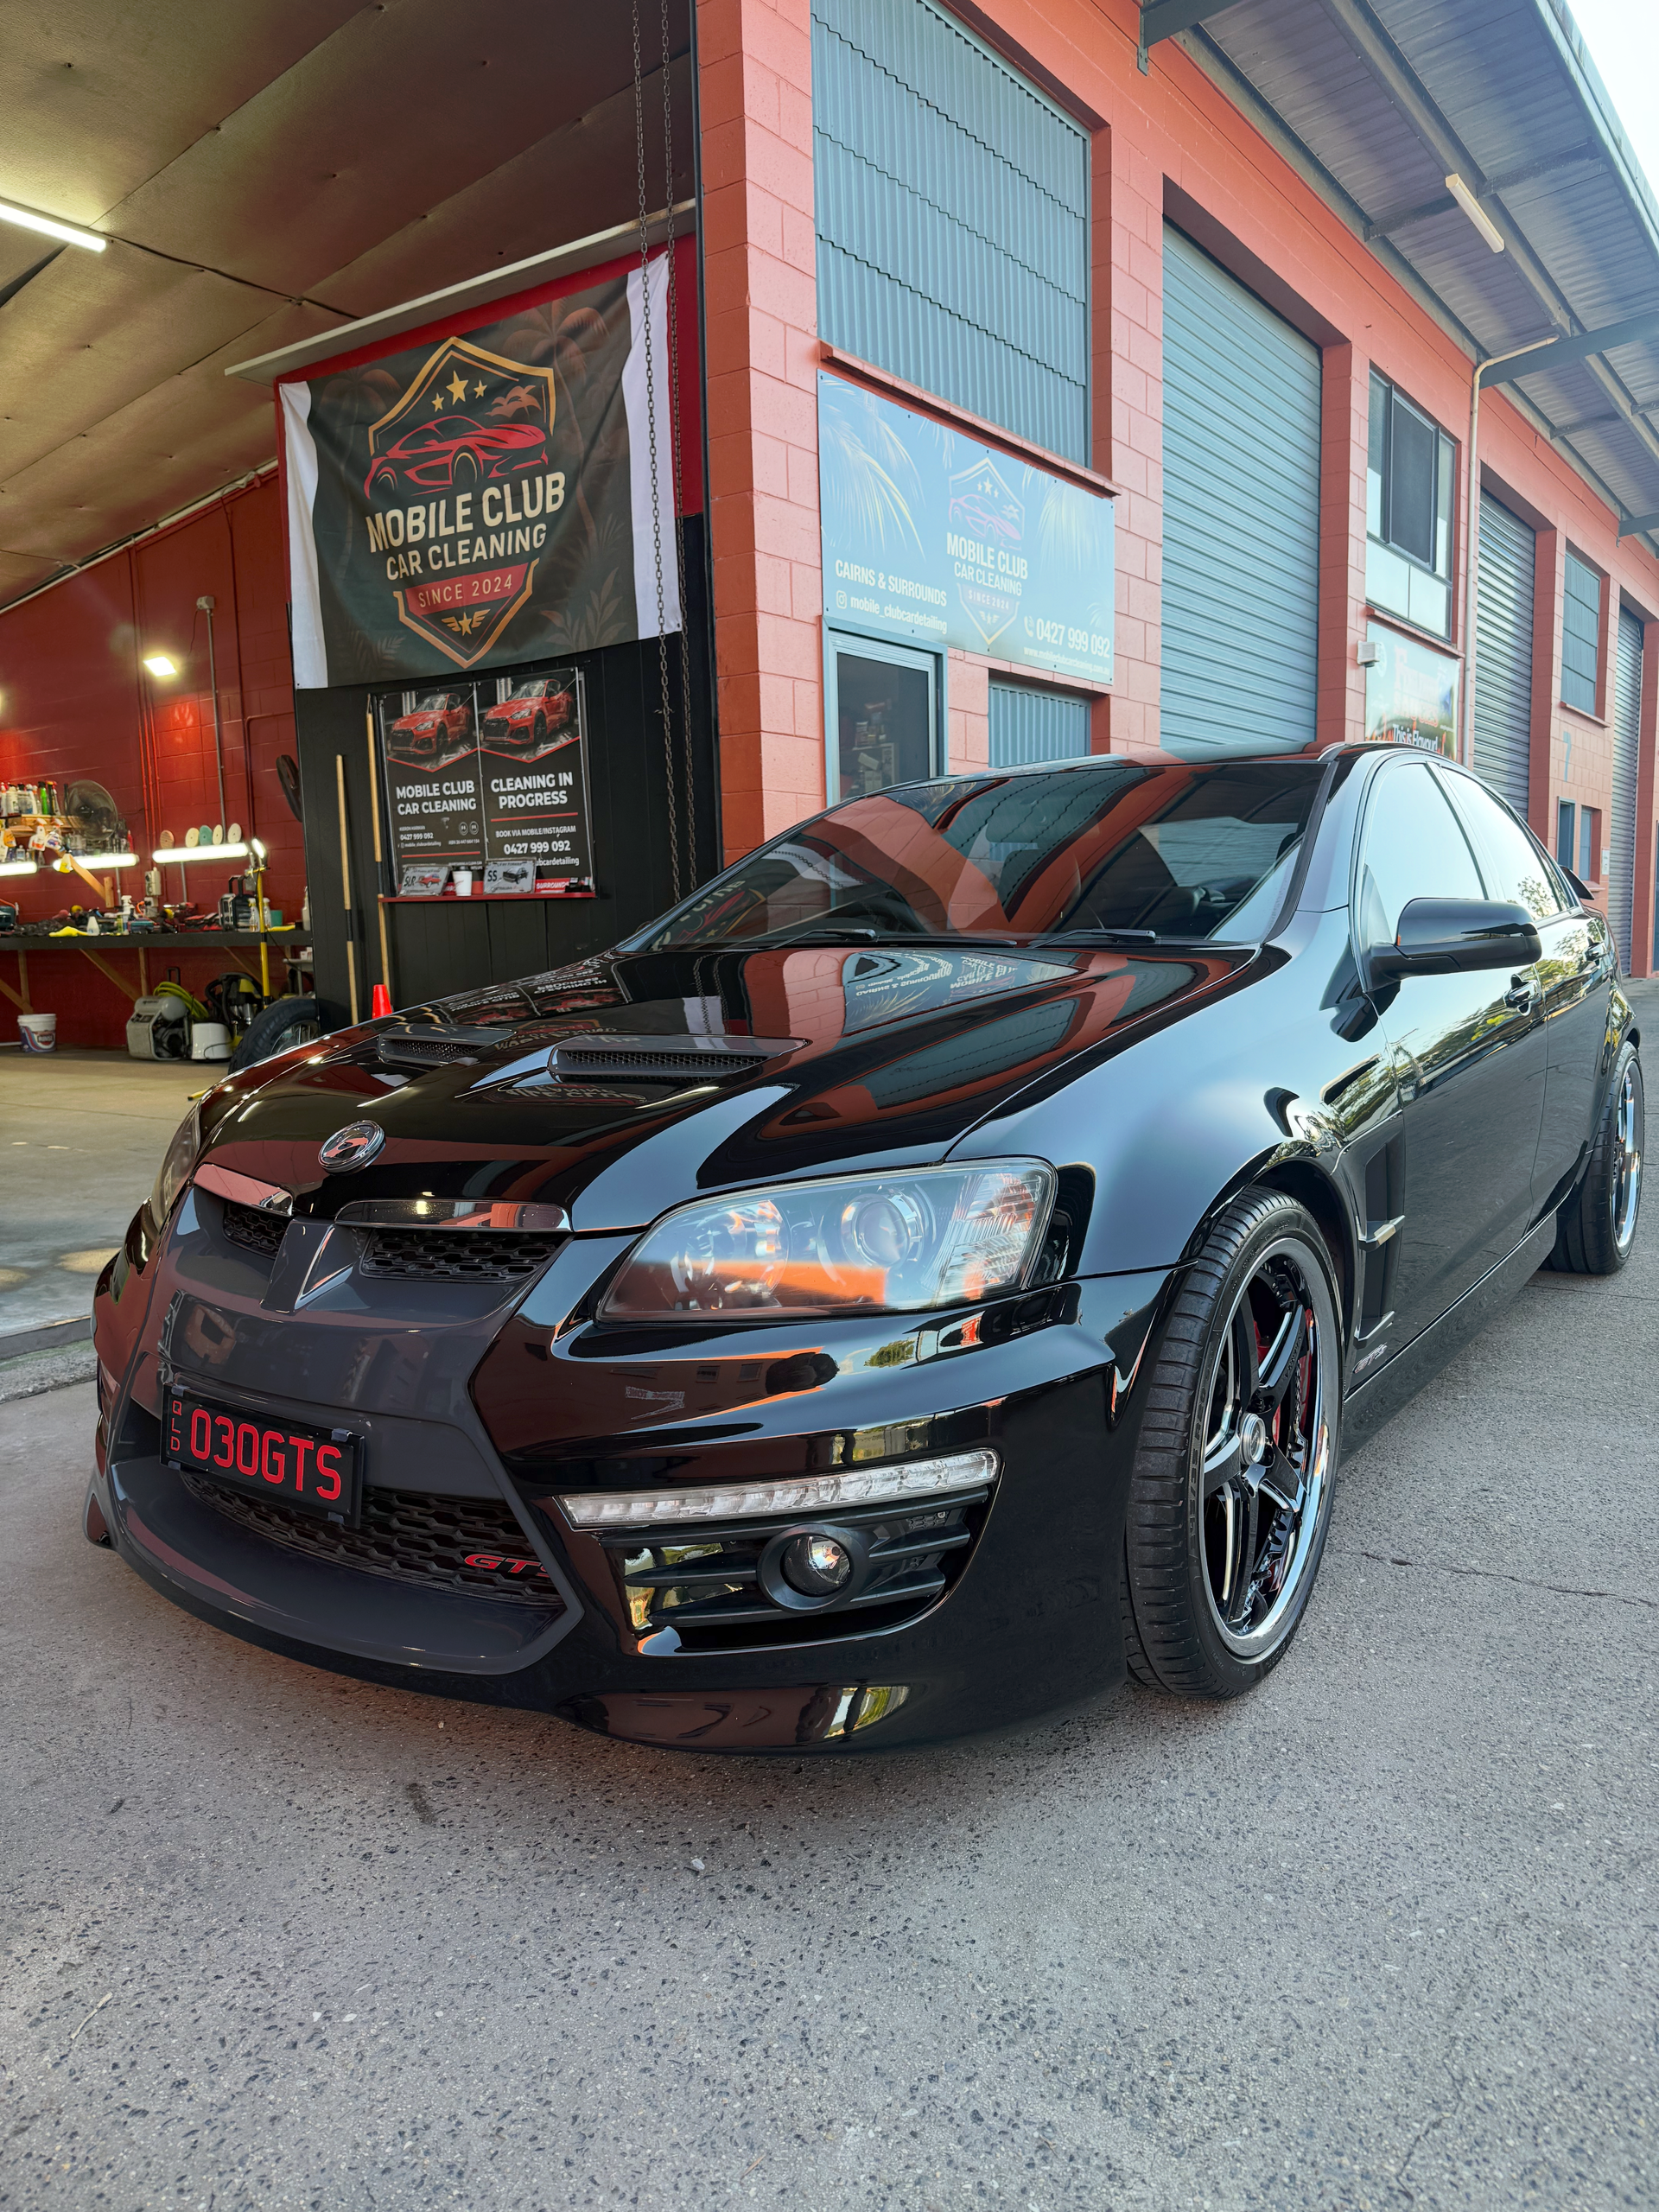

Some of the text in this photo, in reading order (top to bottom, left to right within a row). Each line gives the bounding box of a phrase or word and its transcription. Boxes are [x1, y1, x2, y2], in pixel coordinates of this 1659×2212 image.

[365, 472, 566, 553] MOBILE CLUB
[386, 523, 547, 581] CAR CLEANING
[946, 531, 1028, 580] MOBILE CLUB
[418, 574, 512, 608] SINCE 2024
[835, 559, 948, 607] CAIRNS & SURROUNDS
[954, 561, 1022, 597] CAR CLEANING
[850, 596, 948, 635] mobile_clubcardetailing
[968, 589, 1009, 610] SINCE 2024
[1035, 618, 1110, 658] 0427 999 092
[1392, 723, 1406, 743] This
[1406, 728, 1412, 745] is
[1562, 731, 1572, 783] 7
[396, 780, 475, 800] MOBILE CLUB
[490, 772, 574, 793] CLEANING IN
[397, 798, 477, 816] CAR CLEANING
[499, 790, 568, 810] PROGRESS
[399, 833, 413, 842] 0427
[495, 830, 512, 838] BOOK
[521, 825, 576, 836] MOBILE/INSTAGRAM
[503, 840, 571, 855] 0427 999 092
[487, 869, 498, 882] SS
[170, 1400, 182, 1452] QLD
[190, 1408, 342, 1501] 030GTS
